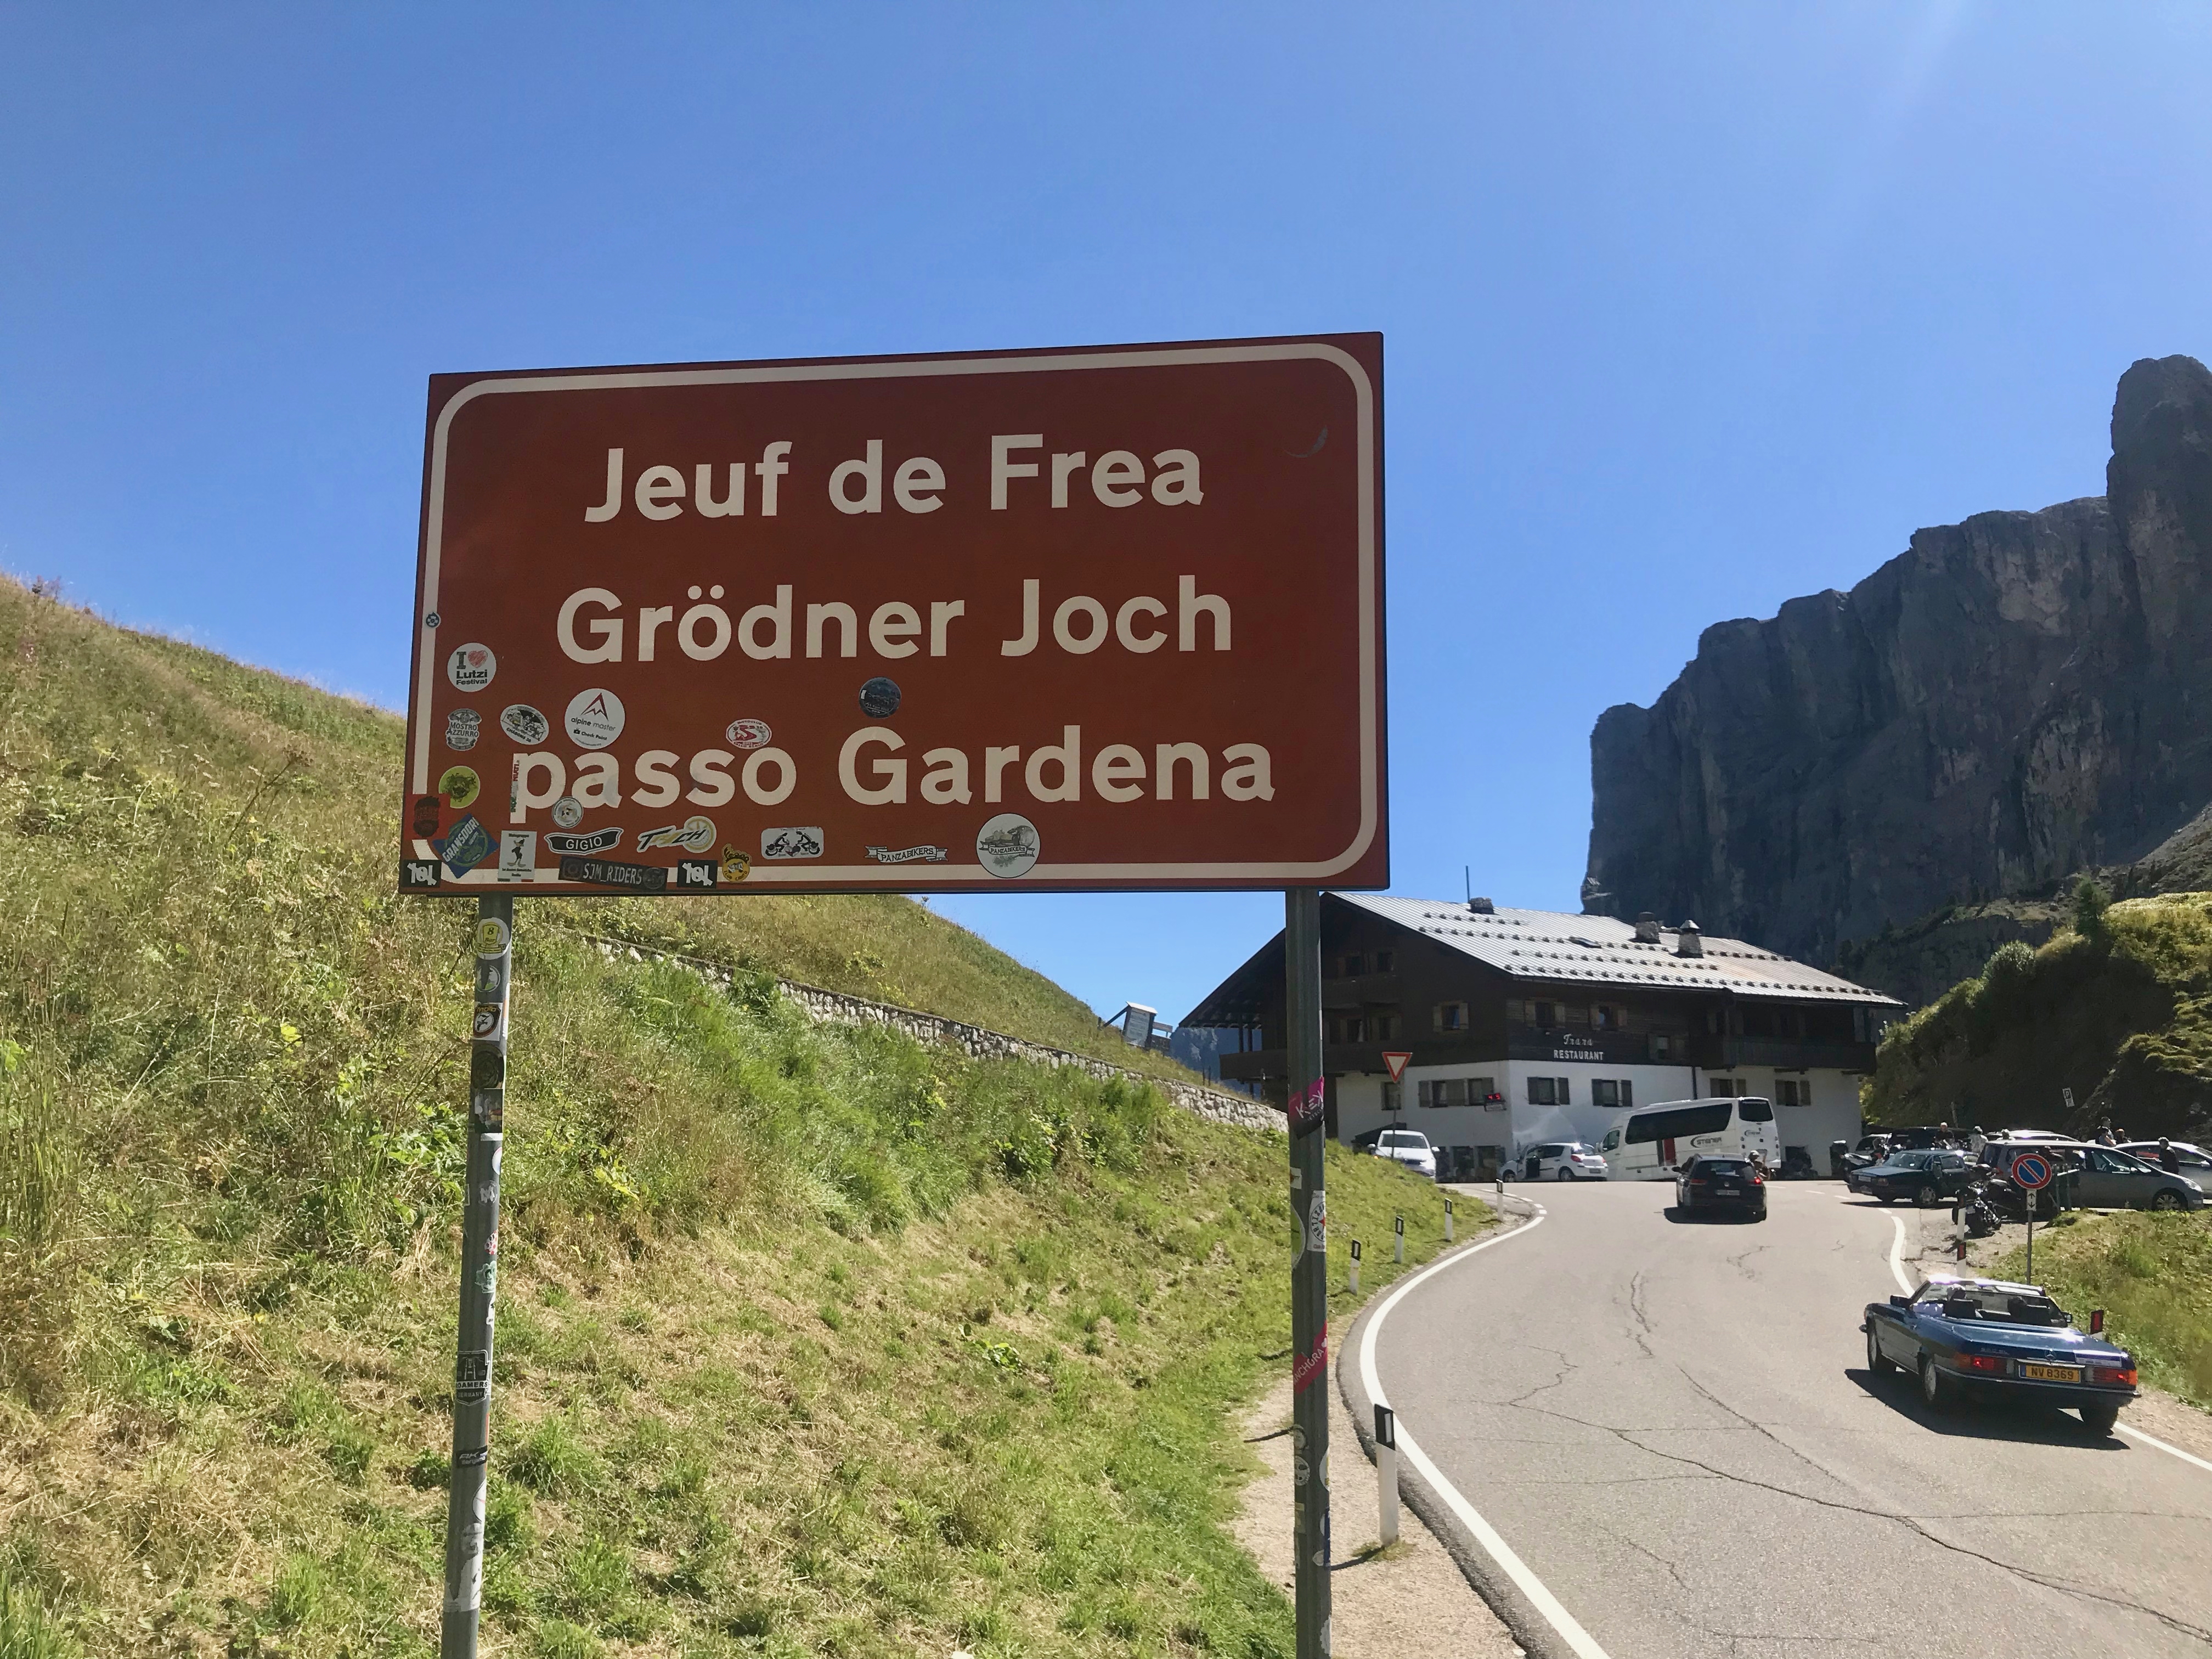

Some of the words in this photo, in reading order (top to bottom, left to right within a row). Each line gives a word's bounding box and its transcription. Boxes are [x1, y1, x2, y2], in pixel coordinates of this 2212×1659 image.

[585, 441, 792, 522] Jeuf
[829, 439, 946, 515] de
[991, 433, 1204, 510] Frea
[557, 584, 964, 664] Grödner
[1001, 575, 1231, 657] Joch
[456, 669, 488, 679] Lutzi
[450, 722, 477, 731] MOSTRO
[571, 717, 591, 726] alpine
[593, 721, 616, 731] master
[446, 728, 479, 737] AZZURRO
[510, 747, 797, 824] passo
[838, 725, 1276, 805] Gardena
[566, 837, 602, 850] GIGIO
[990, 846, 1025, 854] PANZABIKERS
[881, 848, 934, 862] PANZABIKERS
[583, 863, 643, 885] SJM_RIDERS
[1553, 1049, 1604, 1060] RESTAURANT
